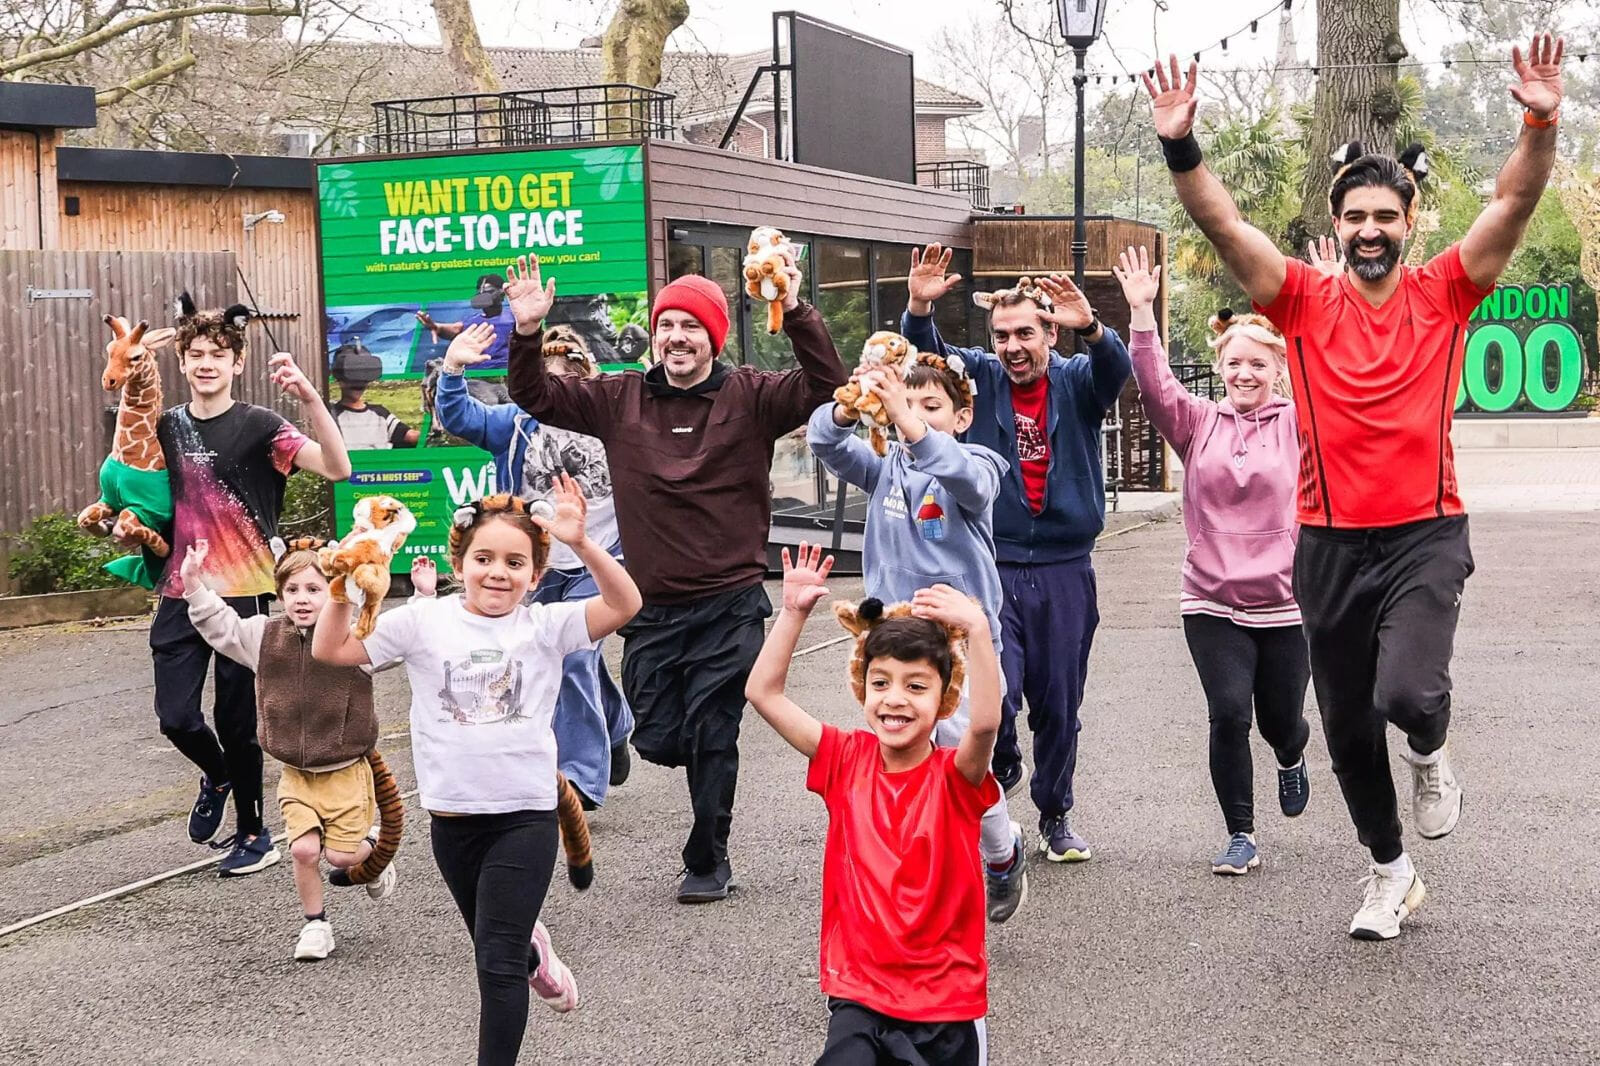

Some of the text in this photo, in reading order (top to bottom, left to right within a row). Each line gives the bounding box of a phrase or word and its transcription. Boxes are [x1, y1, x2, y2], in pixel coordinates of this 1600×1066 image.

[383, 171, 574, 217] WANT TO GET
[379, 209, 584, 255] FACE-TO-FACE
[365, 262, 387, 273] with
[389, 260, 429, 272] nature's
[430, 258, 473, 272] greatest
[557, 253, 577, 265] you
[578, 250, 601, 262] can!
[1469, 286, 1569, 321] NDON
[1454, 323, 1582, 412] OO
[376, 473, 382, 482] A
[382, 472, 403, 482] MUST
[405, 544, 446, 554] NEVER
